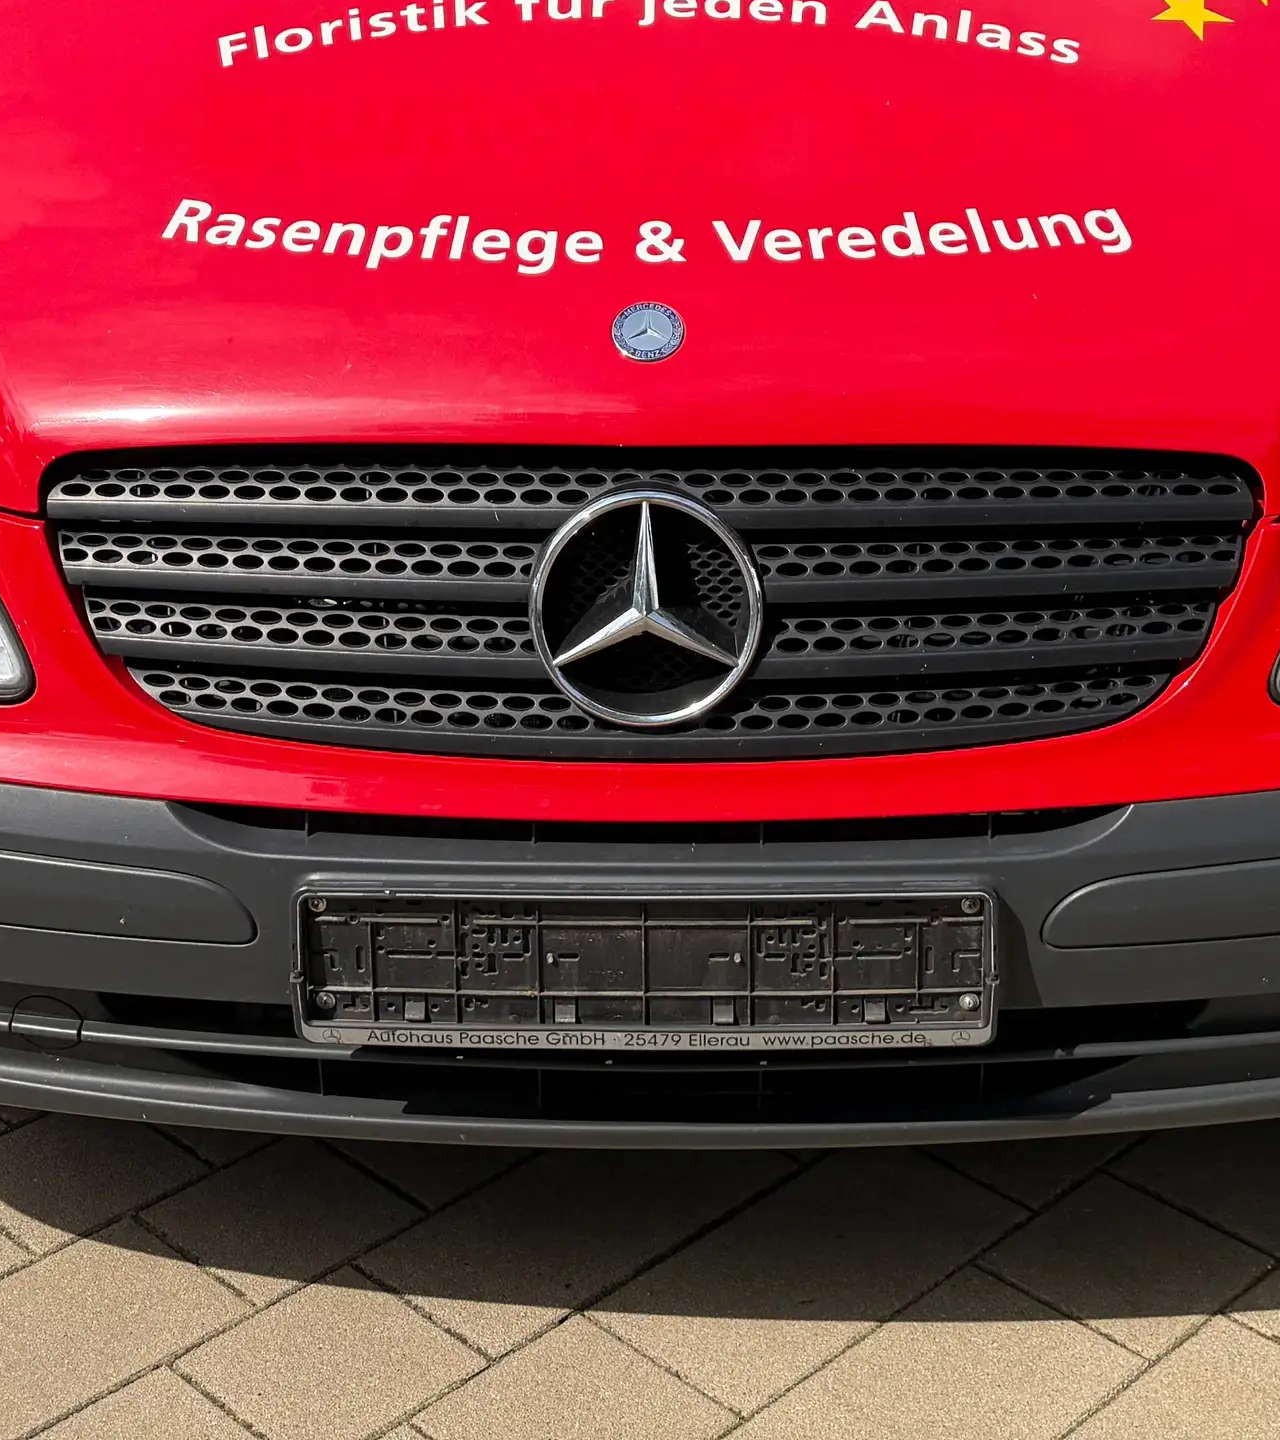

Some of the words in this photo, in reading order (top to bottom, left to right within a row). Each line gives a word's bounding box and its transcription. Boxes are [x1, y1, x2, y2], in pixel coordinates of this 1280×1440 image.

[855, 0, 1080, 64] Anlass
[161, 198, 604, 275] Rasenpflege
[635, 220, 687, 263] &
[711, 208, 1132, 262] Veredelung
[623, 303, 674, 318] MERCEDES
[634, 349, 662, 359] BENZ
[366, 1030, 454, 1044] Autohaus
[459, 1031, 540, 1046] Paasche
[545, 1032, 606, 1046] GmbH
[624, 1033, 682, 1047] 25479
[688, 1033, 751, 1047] Ellerau
[762, 1031, 926, 1048] www.paasche.de
